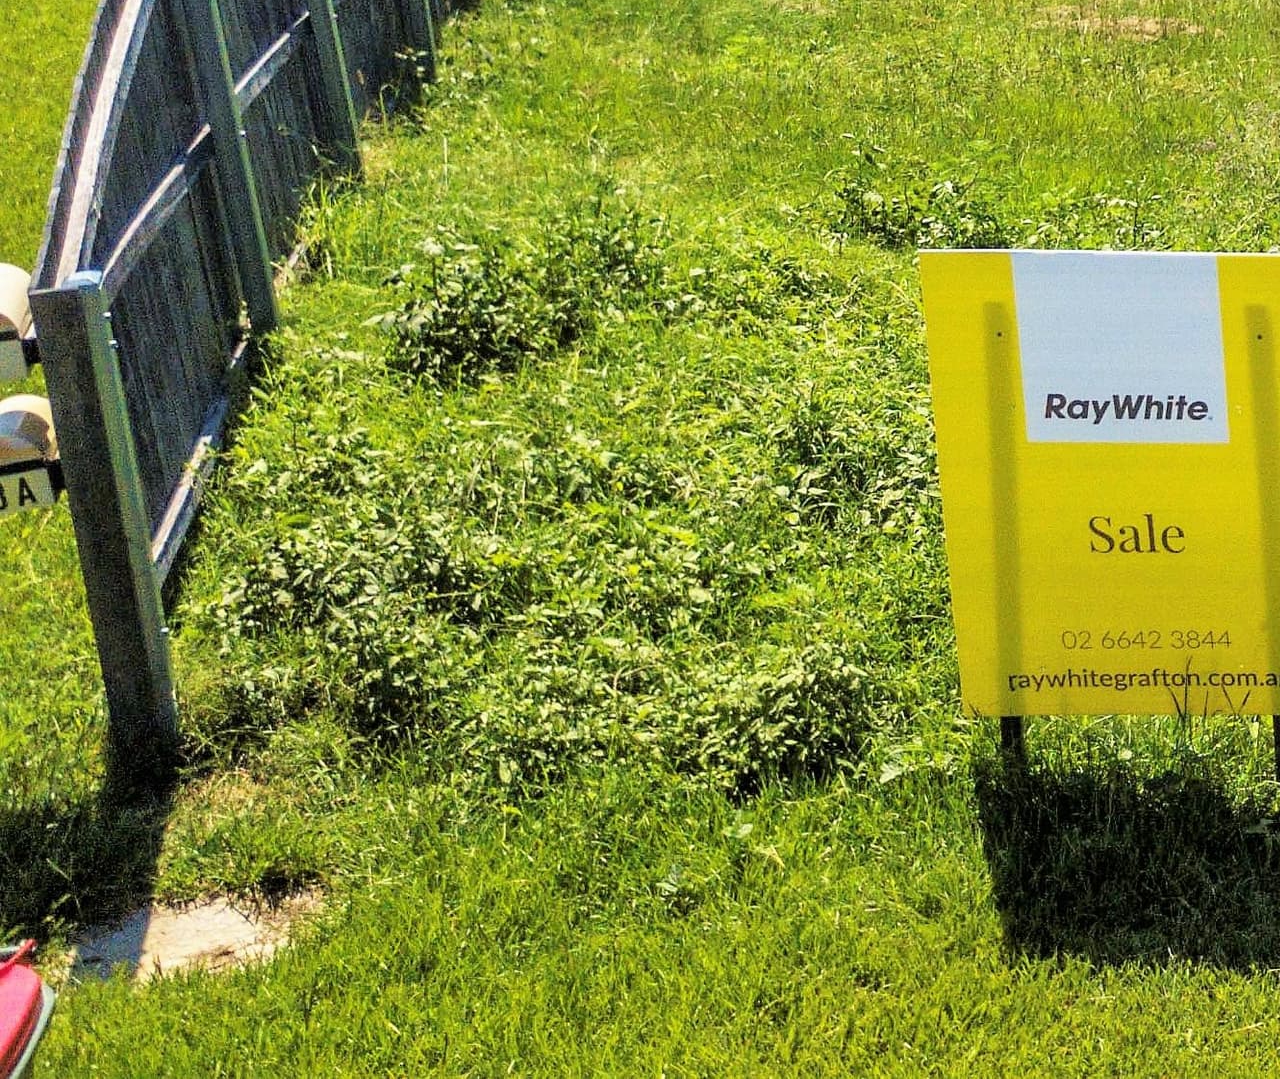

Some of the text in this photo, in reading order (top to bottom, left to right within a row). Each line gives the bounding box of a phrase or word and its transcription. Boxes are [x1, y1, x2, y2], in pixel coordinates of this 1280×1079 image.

[1088, 513, 1186, 554] Sale
[1061, 630, 1232, 650] 02 6642 3844
